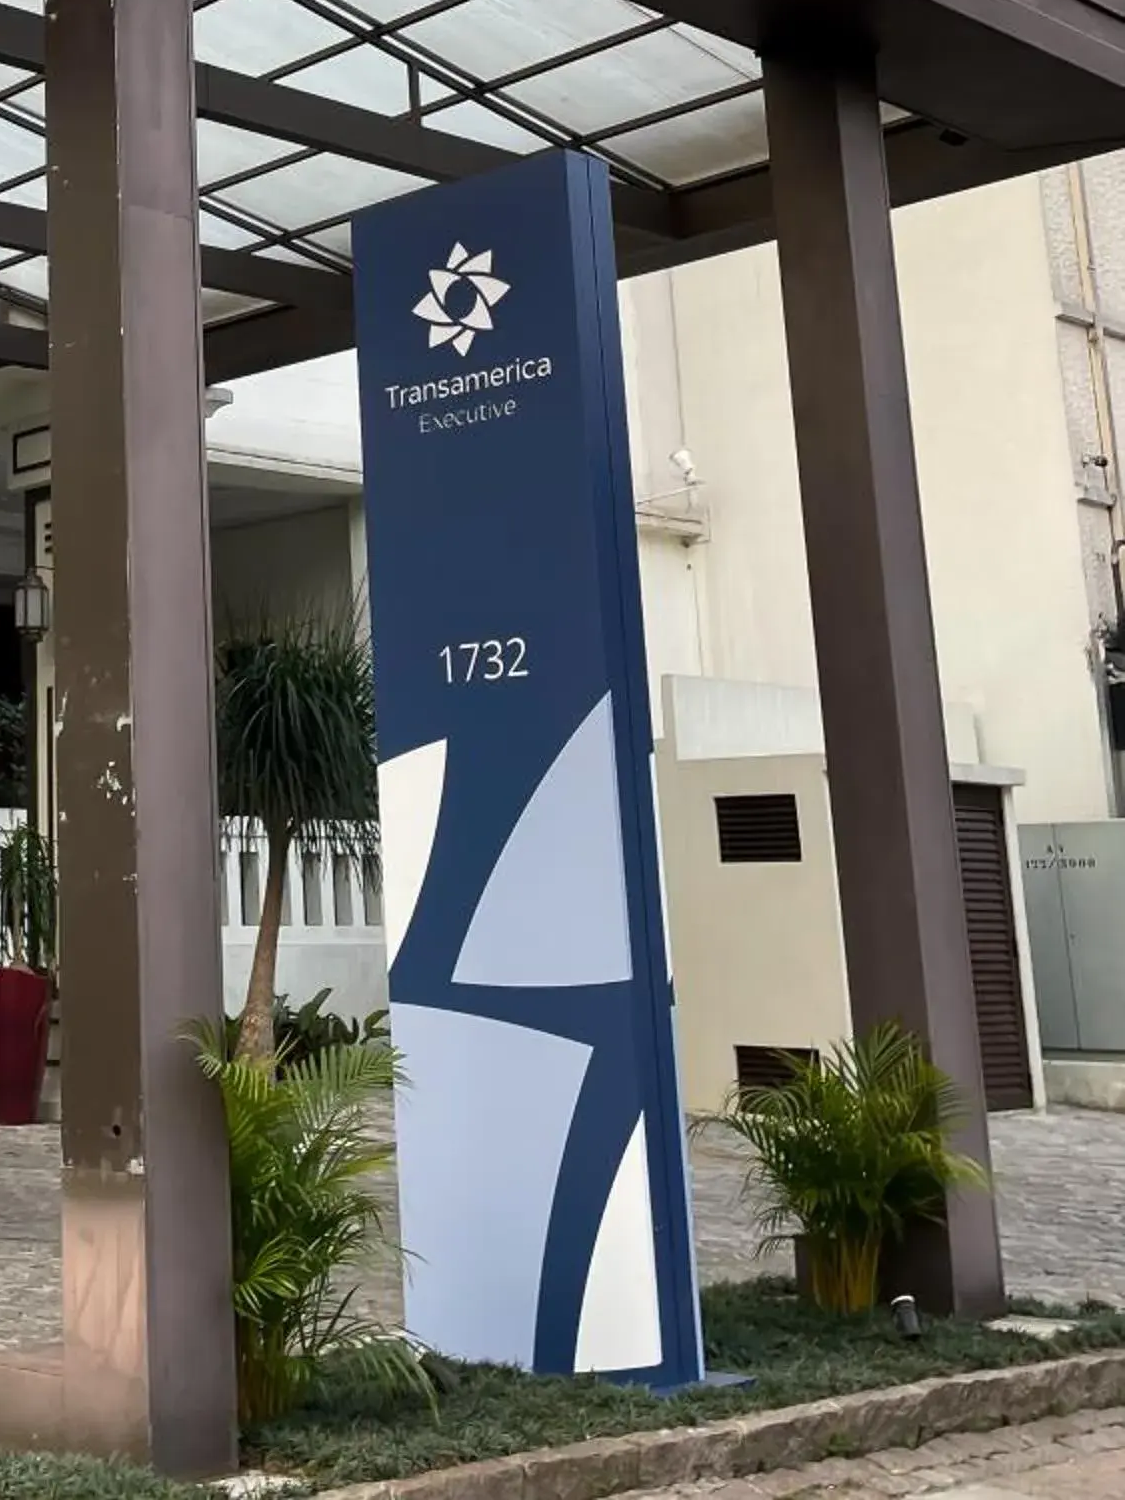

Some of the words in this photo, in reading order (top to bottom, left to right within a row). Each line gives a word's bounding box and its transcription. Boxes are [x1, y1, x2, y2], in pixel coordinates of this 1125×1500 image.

[385, 356, 553, 409] Transamerica
[419, 398, 517, 434] Executive
[439, 637, 529, 683] 1732
